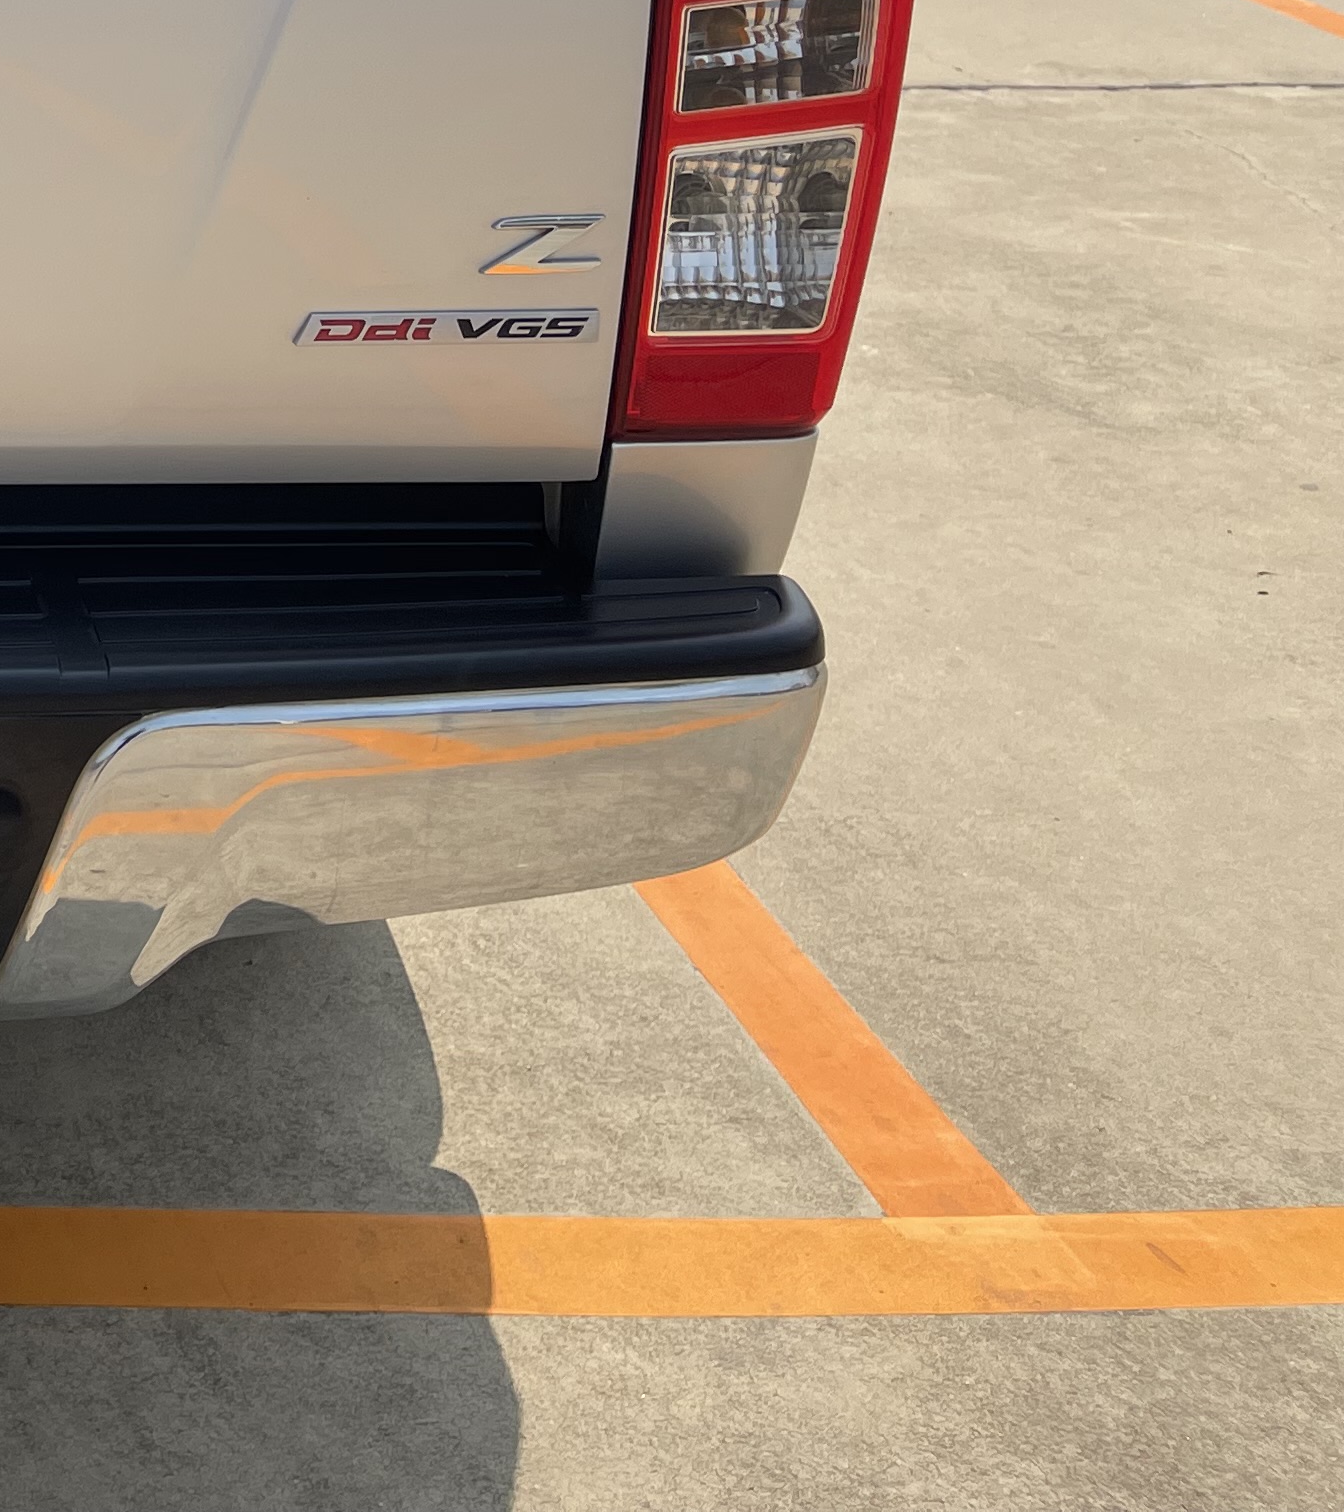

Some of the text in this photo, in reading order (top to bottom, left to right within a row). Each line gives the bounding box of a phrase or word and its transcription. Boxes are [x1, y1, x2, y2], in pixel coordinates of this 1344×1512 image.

[479, 214, 606, 275] Z
[313, 316, 590, 342] Ddi VGS
